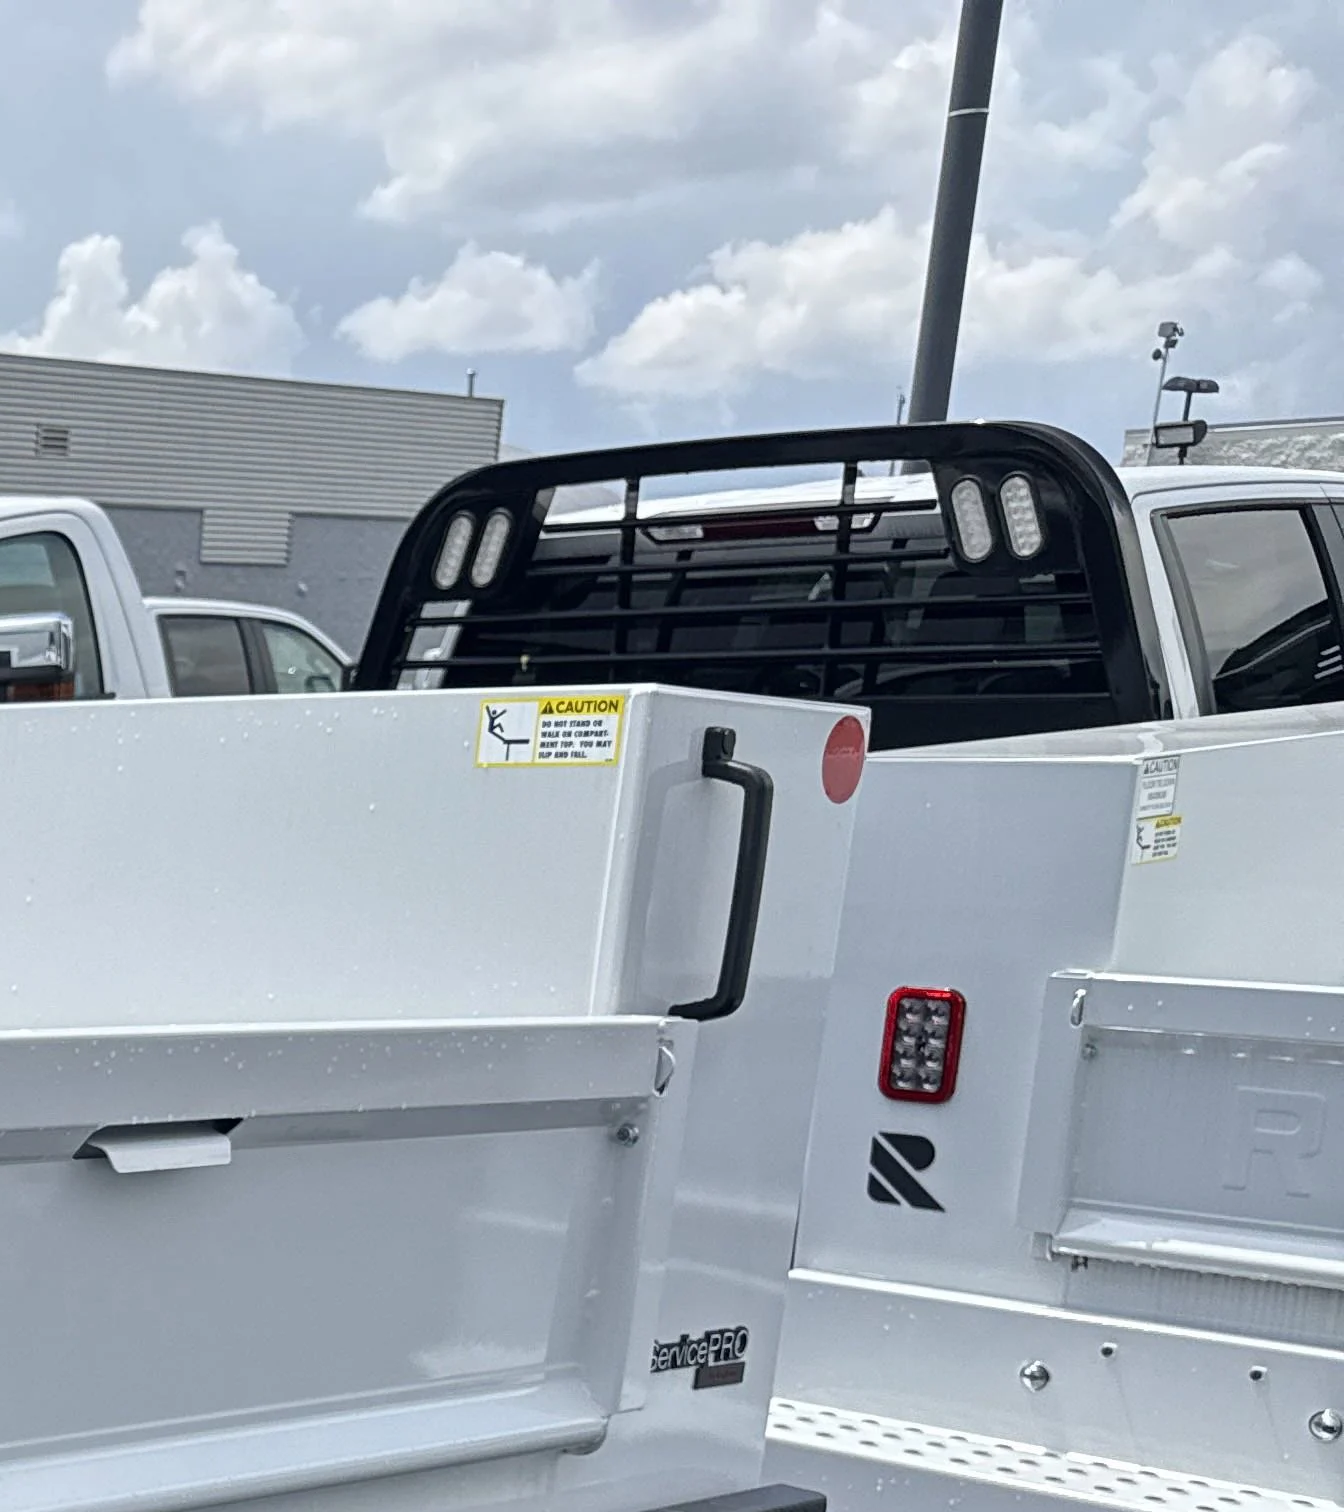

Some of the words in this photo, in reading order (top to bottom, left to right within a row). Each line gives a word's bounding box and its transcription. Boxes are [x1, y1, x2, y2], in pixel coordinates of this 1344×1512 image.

[556, 700, 619, 713] CAUTION
[541, 720, 552, 728] DO
[554, 720, 567, 728] NOT
[569, 720, 591, 728] STAND
